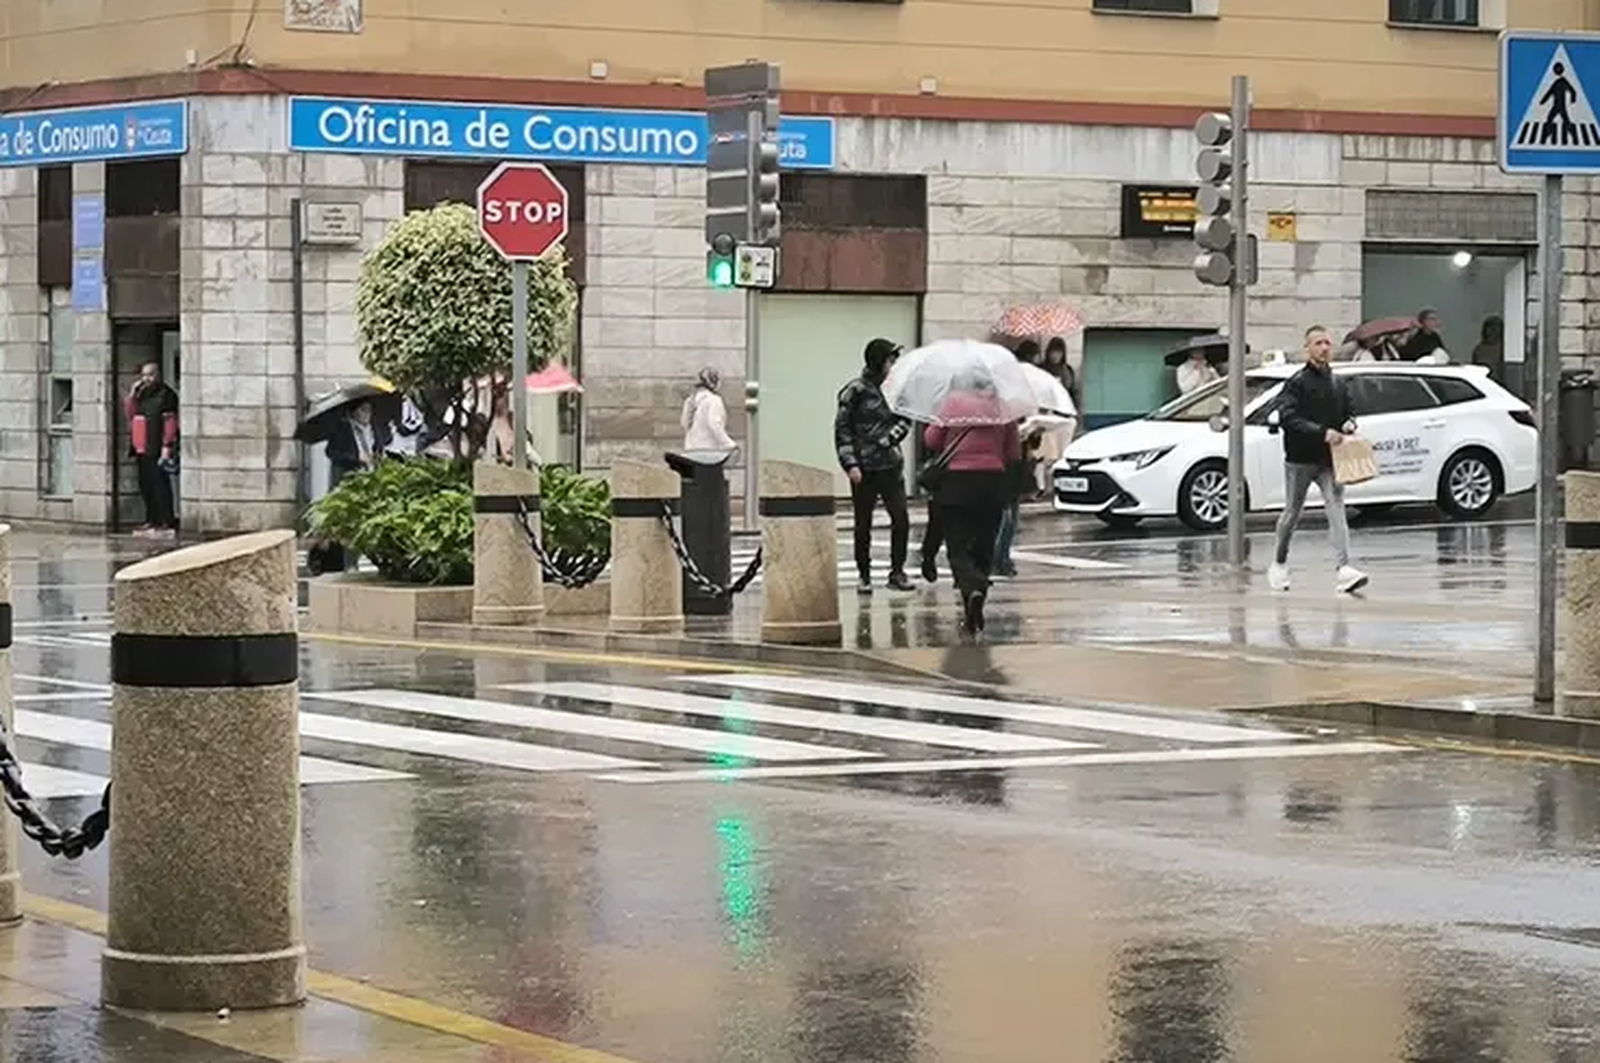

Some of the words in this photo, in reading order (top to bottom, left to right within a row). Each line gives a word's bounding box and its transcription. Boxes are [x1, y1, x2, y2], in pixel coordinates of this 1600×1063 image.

[13, 120, 34, 155] de
[38, 120, 119, 152] Consumo
[319, 105, 452, 146] Oficina
[465, 110, 510, 148] de
[523, 115, 698, 154] Consumo
[485, 200, 562, 223] STOP
